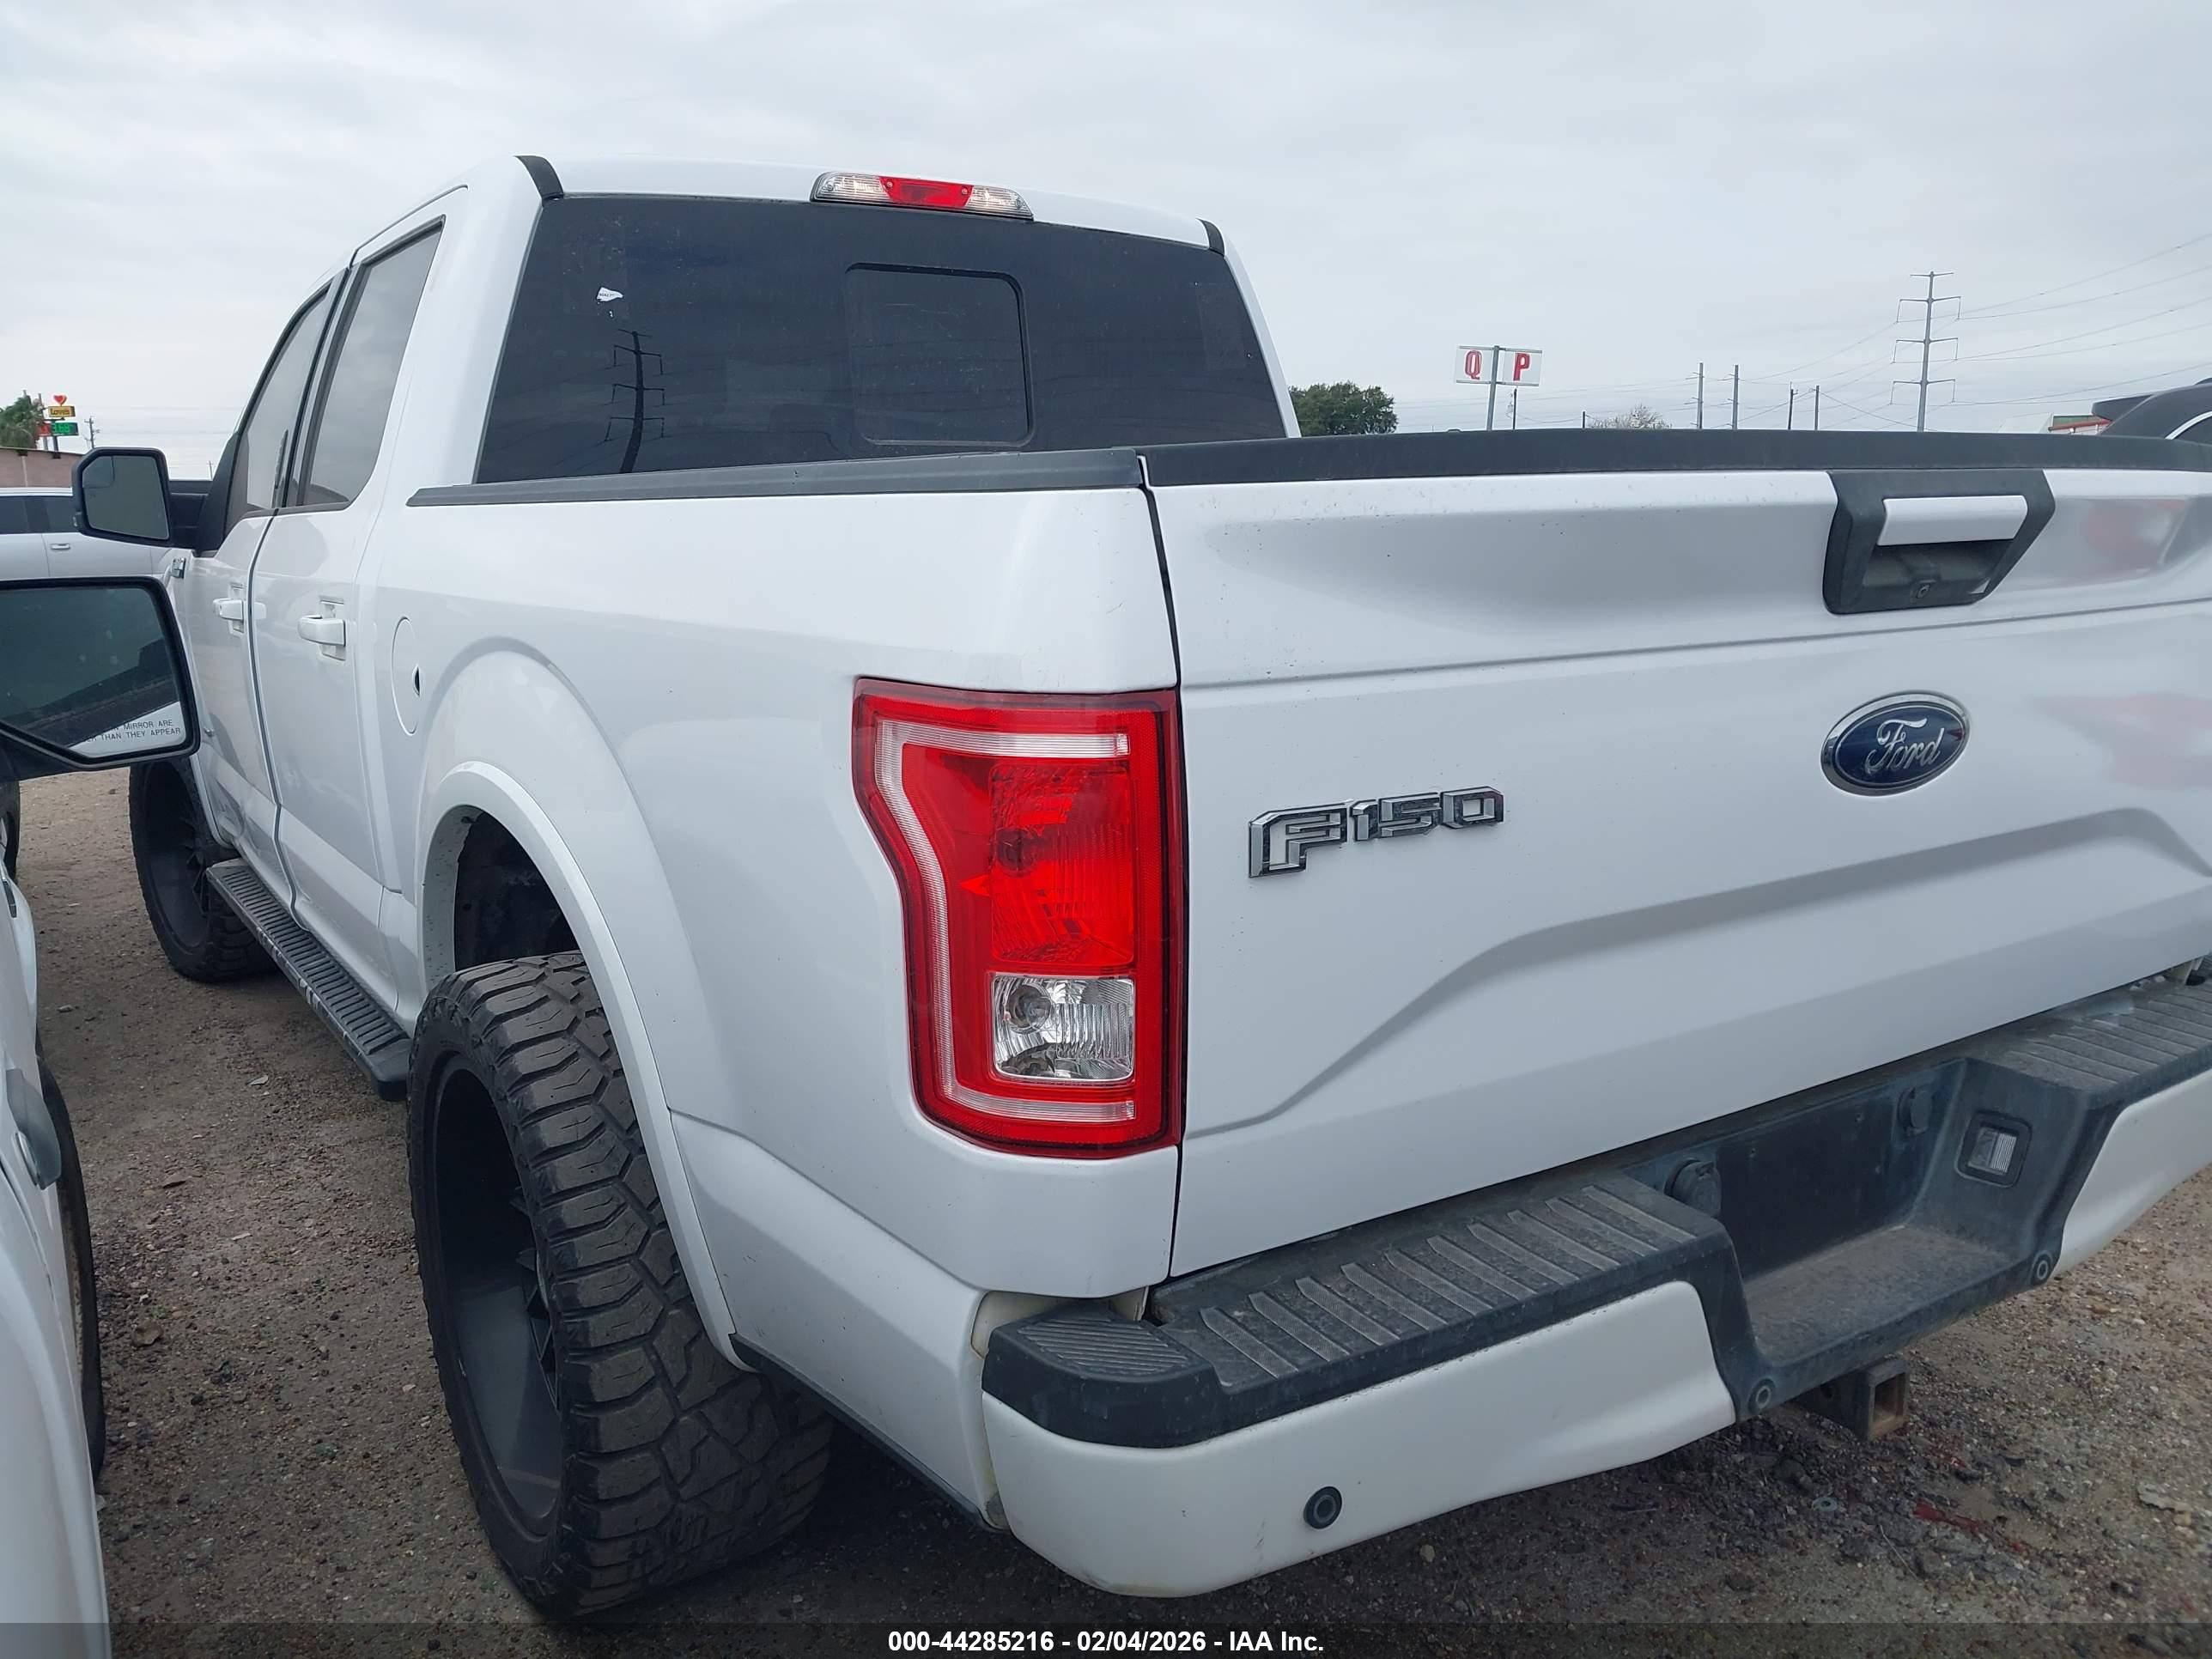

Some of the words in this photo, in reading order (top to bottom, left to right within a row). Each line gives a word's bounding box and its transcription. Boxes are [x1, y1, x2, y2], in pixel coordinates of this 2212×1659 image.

[1465, 350, 1482, 380] Q
[1513, 352, 1530, 381] P
[101, 732, 122, 741] THAN
[125, 731, 146, 739] THEY
[150, 727, 181, 736] APPEAR
[123, 720, 154, 730] MIRROR
[1865, 718, 1945, 775] Ford
